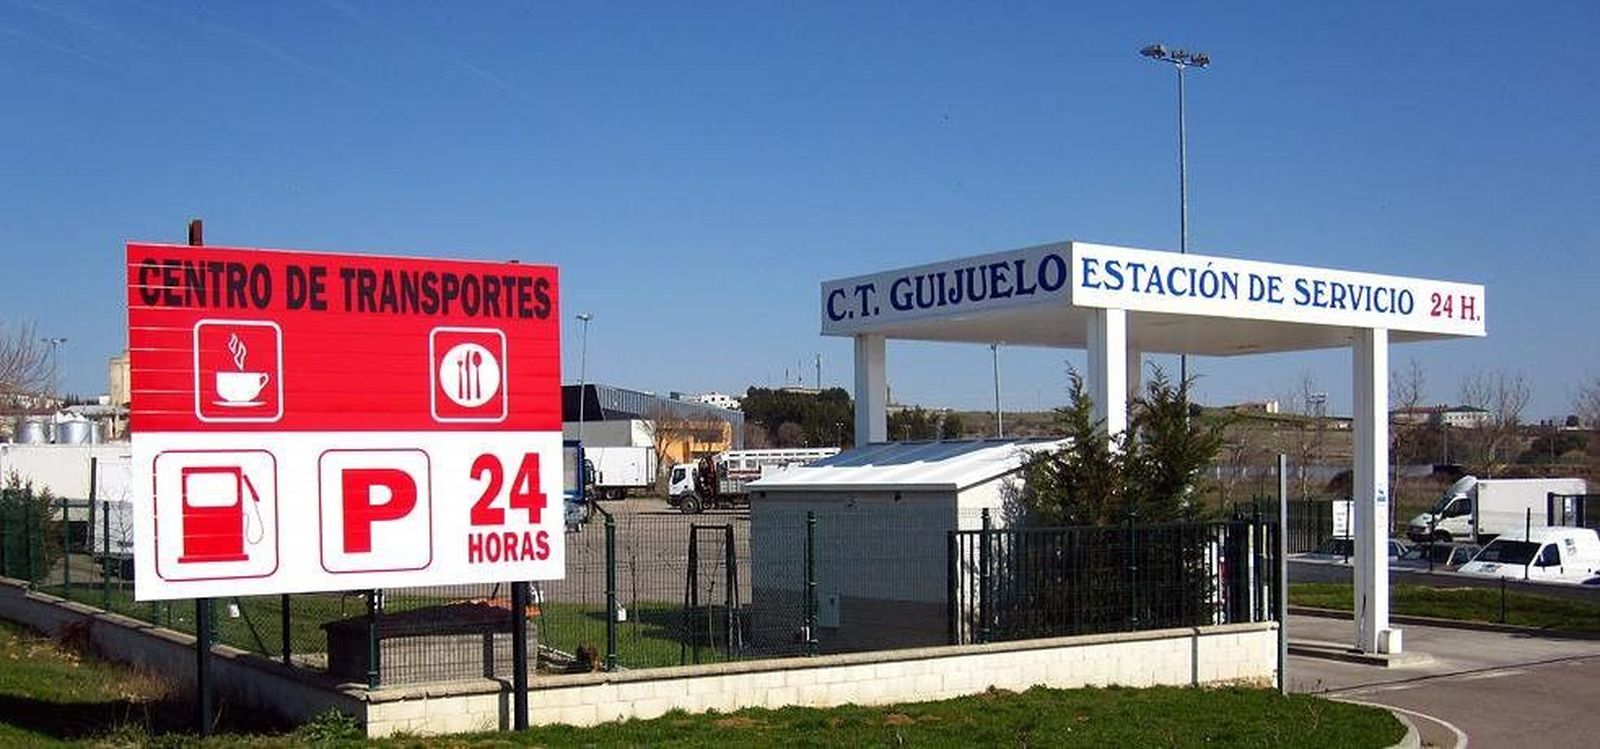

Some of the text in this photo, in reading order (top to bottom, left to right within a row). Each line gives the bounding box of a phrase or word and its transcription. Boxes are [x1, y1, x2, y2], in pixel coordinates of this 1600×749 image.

[138, 258, 552, 319] CENTRO DE TRANSPORTES
[827, 253, 1067, 321] C.T. GUIJUELO
[1081, 257, 1481, 321] ESTACIÓN DE SERVICIO 24 H.
[341, 468, 417, 553] P
[469, 452, 548, 526] 24
[468, 530, 551, 564] HORAS
